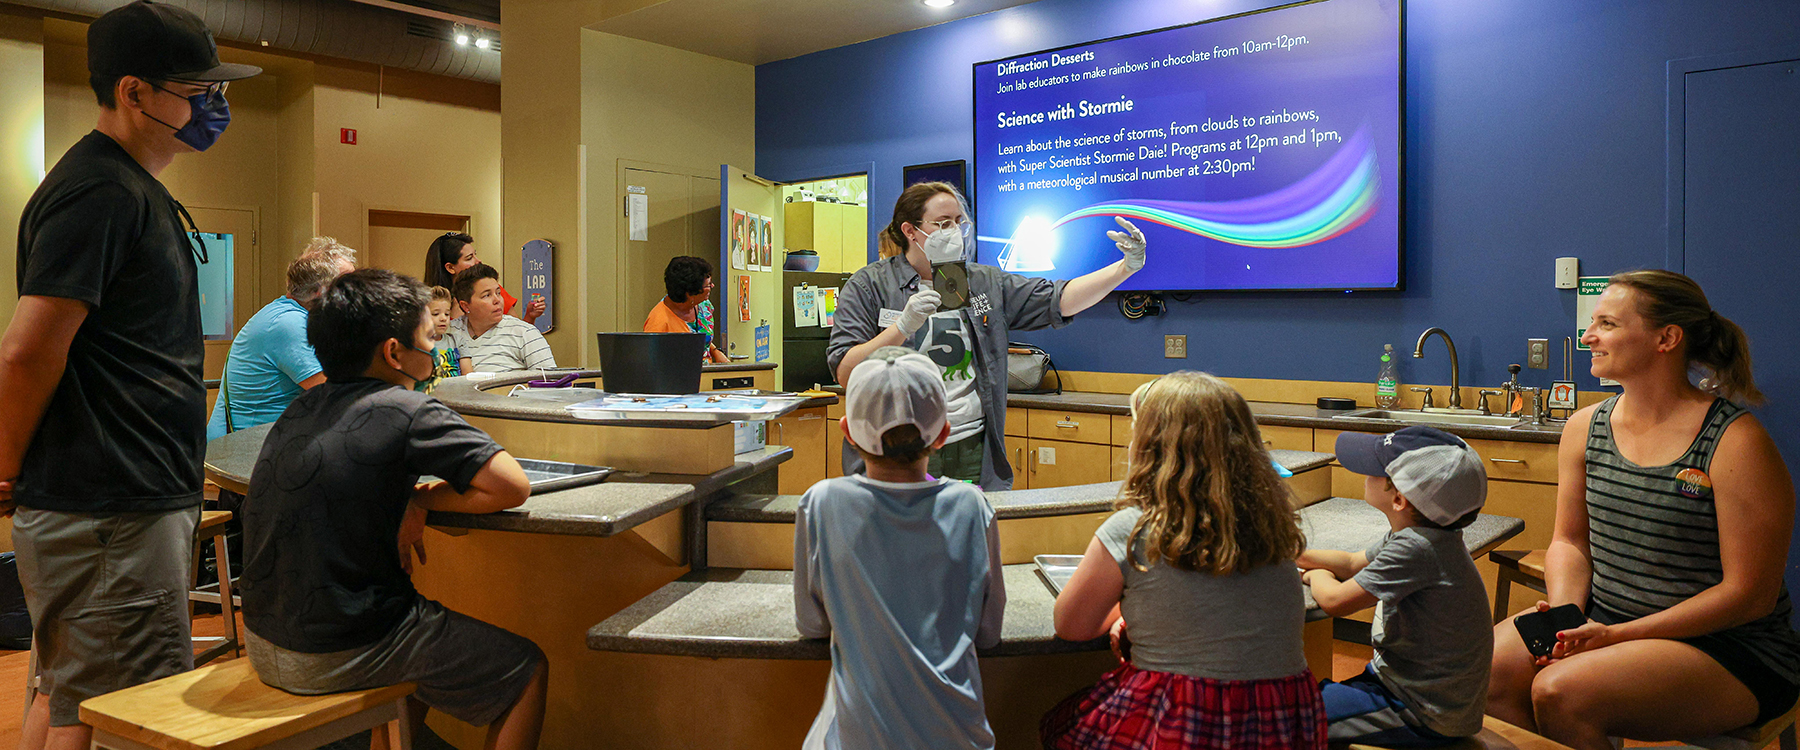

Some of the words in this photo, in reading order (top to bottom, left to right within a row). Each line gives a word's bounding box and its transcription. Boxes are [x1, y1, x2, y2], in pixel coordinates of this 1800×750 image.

[997, 58, 1048, 76] Diffraction
[1051, 51, 1095, 67] Desserts
[997, 82, 1013, 94] Join
[1015, 79, 1027, 91] lab
[1029, 76, 1069, 89] educators
[1071, 73, 1081, 82] to
[1083, 66, 1107, 80] make
[1109, 61, 1149, 75] rainbows
[1151, 57, 1160, 69] in
[1162, 50, 1211, 67] chocolate
[1213, 45, 1239, 59] from
[1242, 34, 1310, 54] 10am-12pm.
[997, 110, 1045, 128] Science
[1047, 102, 1076, 121] with
[1079, 95, 1134, 117] Stormie
[998, 143, 1024, 155] Learn
[1026, 139, 1053, 152] about
[1055, 135, 1071, 149] the
[1074, 132, 1111, 147] science
[1113, 128, 1125, 142] of
[1127, 127, 1167, 140] storms,
[1170, 121, 1198, 135] from
[1201, 114, 1239, 133] clouds
[1242, 116, 1256, 128] to
[1259, 108, 1320, 125] rainbows,
[998, 160, 1017, 174] with
[1019, 159, 1047, 175] Super
[1049, 152, 1091, 169] Scientist
[1093, 148, 1135, 165] Stormie
[1139, 143, 1168, 160] Daie!
[1171, 142, 1227, 160] Programs
[1229, 139, 1242, 151] at
[1245, 134, 1279, 153] 12pm
[1282, 128, 1306, 146] and
[1310, 128, 1342, 148] 1pm,
[998, 179, 1017, 192] with
[1019, 182, 1026, 191] a
[1027, 171, 1098, 191] meteorological
[1100, 167, 1139, 184] musical
[1141, 164, 1185, 180] number
[1187, 164, 1200, 176] at
[1202, 156, 1256, 178] 2:30pm!
[529, 258, 544, 271] The
[527, 274, 546, 289] LAB
[1681, 482, 1700, 496] LOVE
[1685, 471, 1704, 484] LOVE
